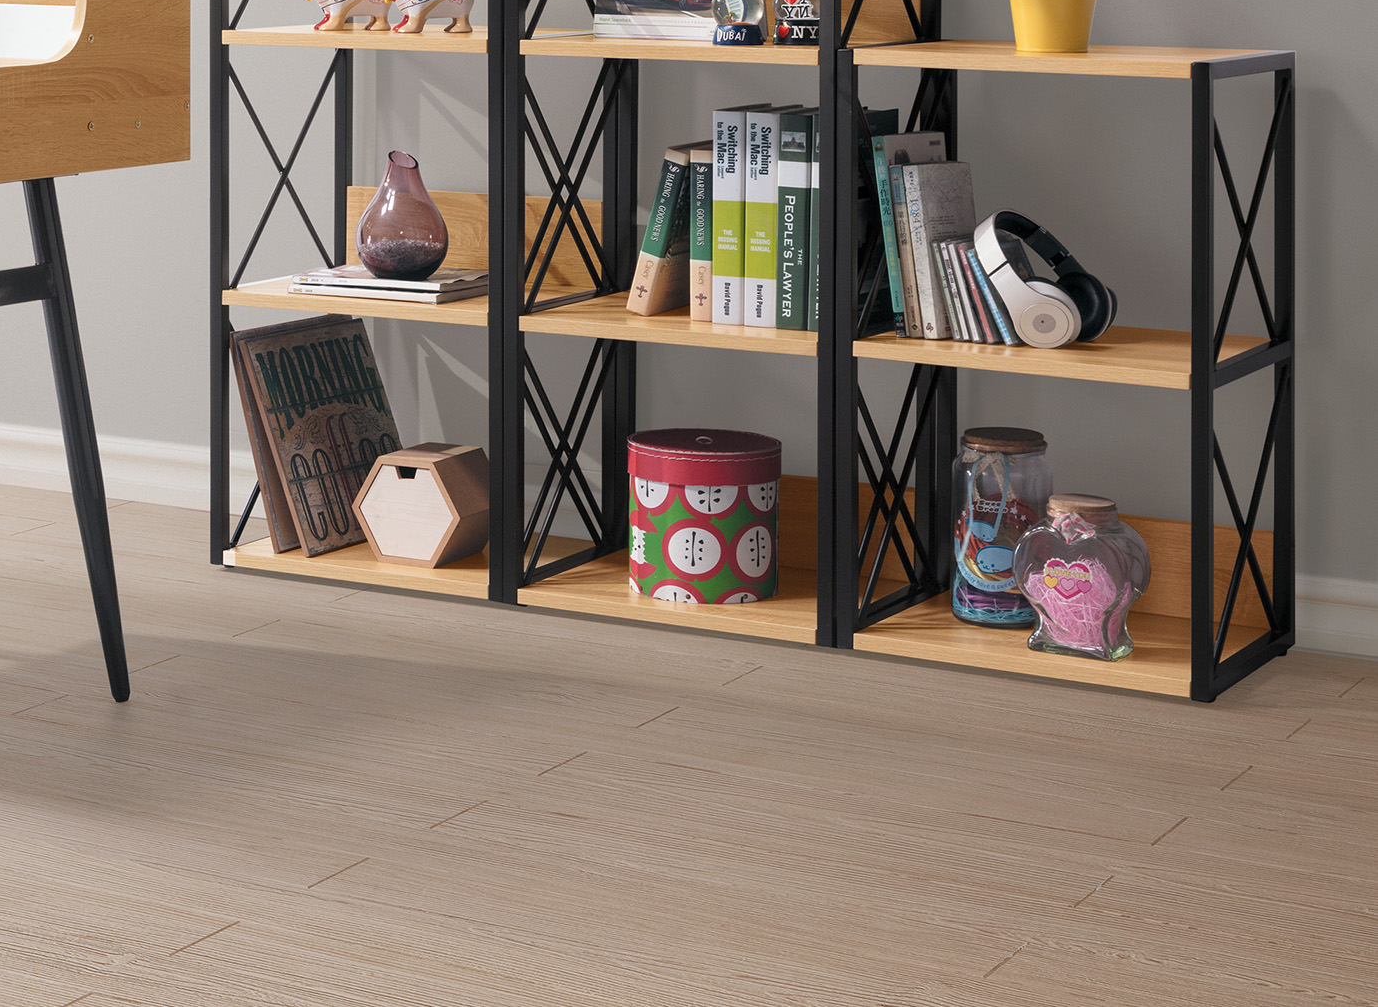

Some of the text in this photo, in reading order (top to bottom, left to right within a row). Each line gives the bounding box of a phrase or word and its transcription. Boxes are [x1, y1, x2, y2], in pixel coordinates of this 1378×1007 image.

[791, 26, 818, 38] NY
[717, 143, 726, 164] Mac
[726, 126, 738, 174] Switching
[751, 144, 760, 165] Mac
[759, 127, 772, 175] Switching
[655, 206, 666, 224] GOOD
[696, 208, 704, 227] GOOD
[910, 199, 920, 224] 1Q84
[651, 222, 662, 242] NEWS
[696, 228, 704, 246] NEWS
[782, 195, 795, 317] PEOPLE'S LAWYER
[255, 334, 389, 439] MORNING
[1049, 568, 1071, 577] LOVE
[1072, 571, 1091, 580] YOU
